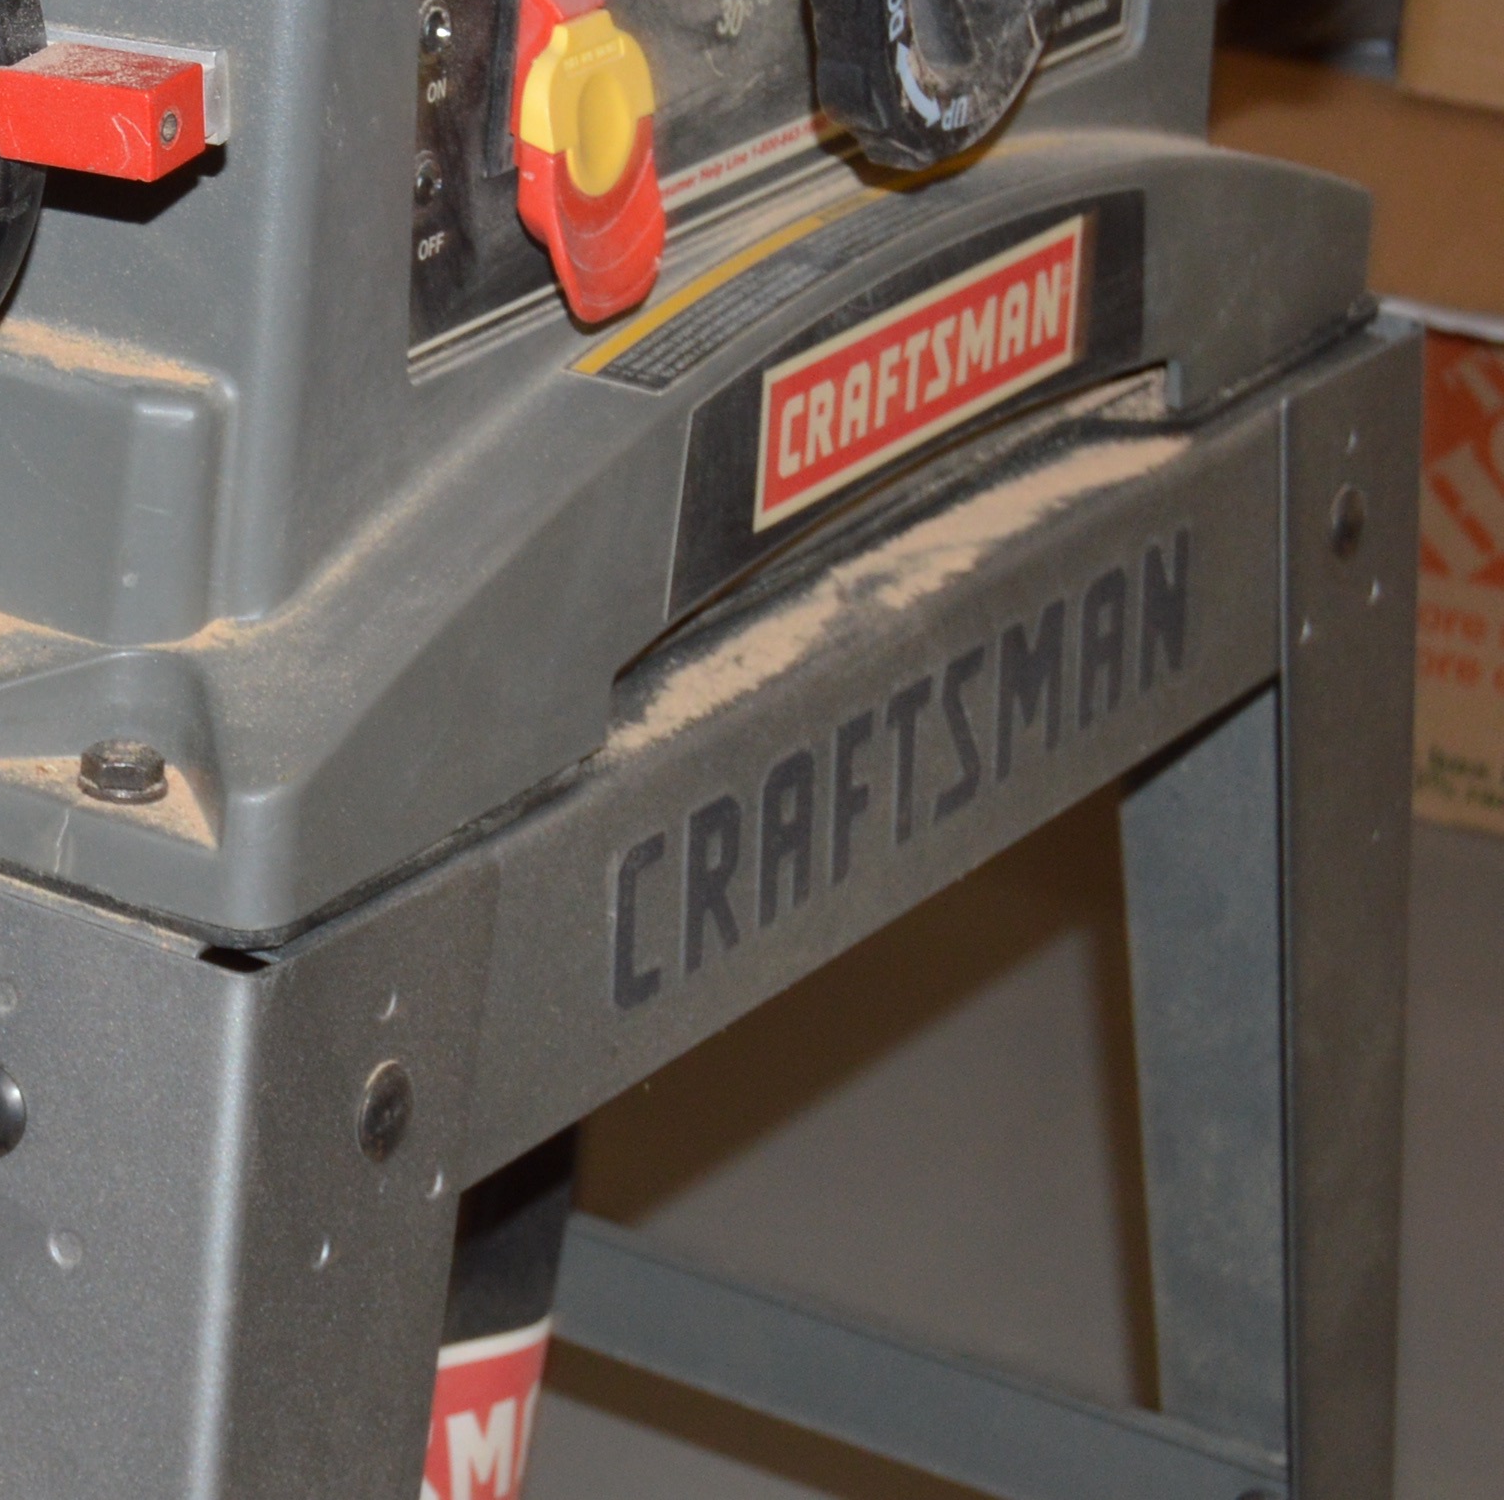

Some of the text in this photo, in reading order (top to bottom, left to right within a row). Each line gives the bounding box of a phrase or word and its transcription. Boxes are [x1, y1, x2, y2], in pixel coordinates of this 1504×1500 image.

[426, 77, 448, 104] ON
[417, 230, 446, 261] OFF
[777, 261, 1064, 480] CRAFTSMAN
[610, 525, 1190, 1012] CRAFTSMAN
